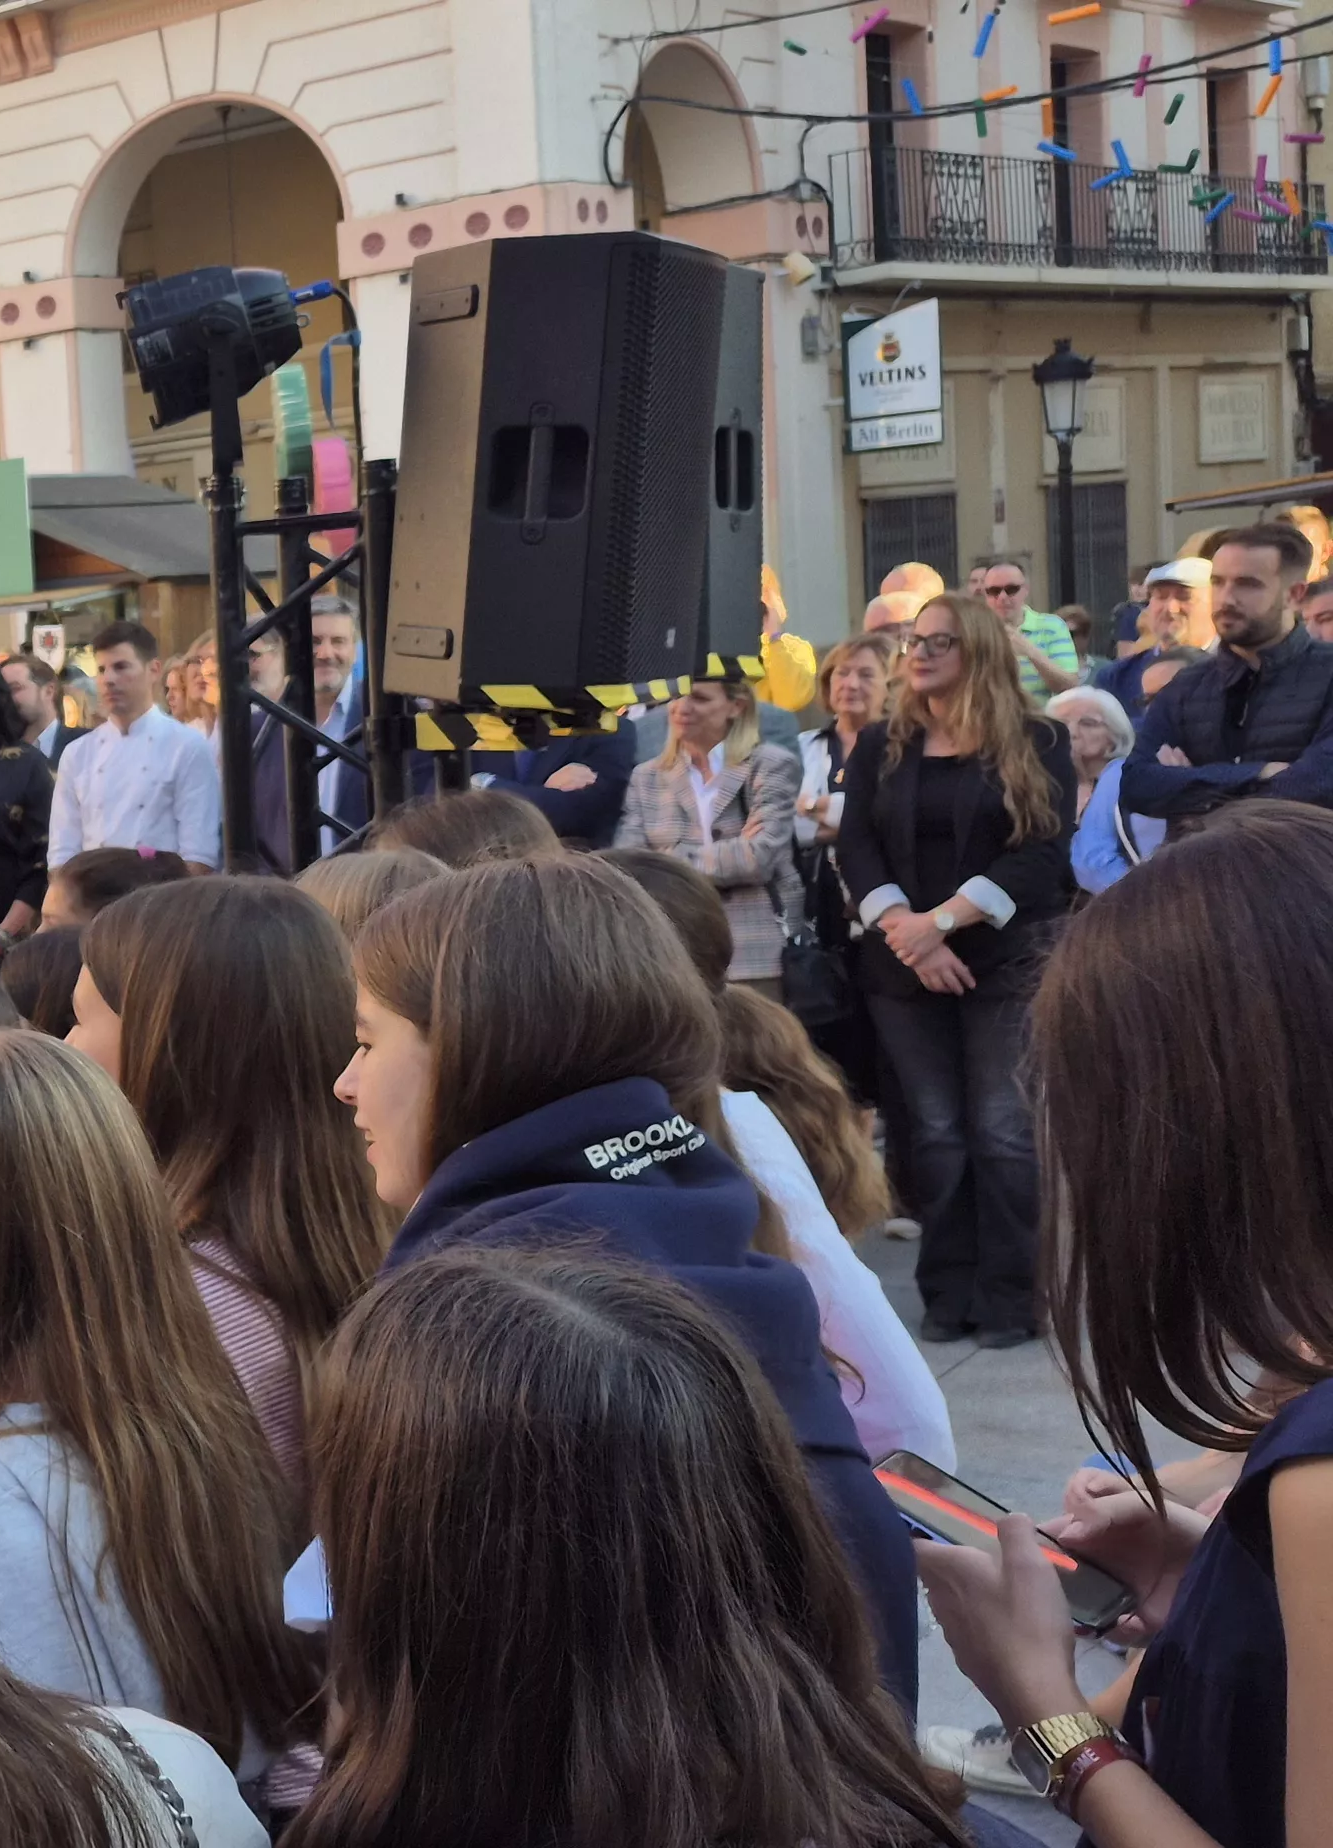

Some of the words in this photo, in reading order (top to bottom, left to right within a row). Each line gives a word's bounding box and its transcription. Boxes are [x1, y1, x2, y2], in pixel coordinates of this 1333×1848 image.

[858, 364, 926, 387] VELTINS
[610, 1152, 653, 1180] Original
[652, 1144, 687, 1161] Sport
